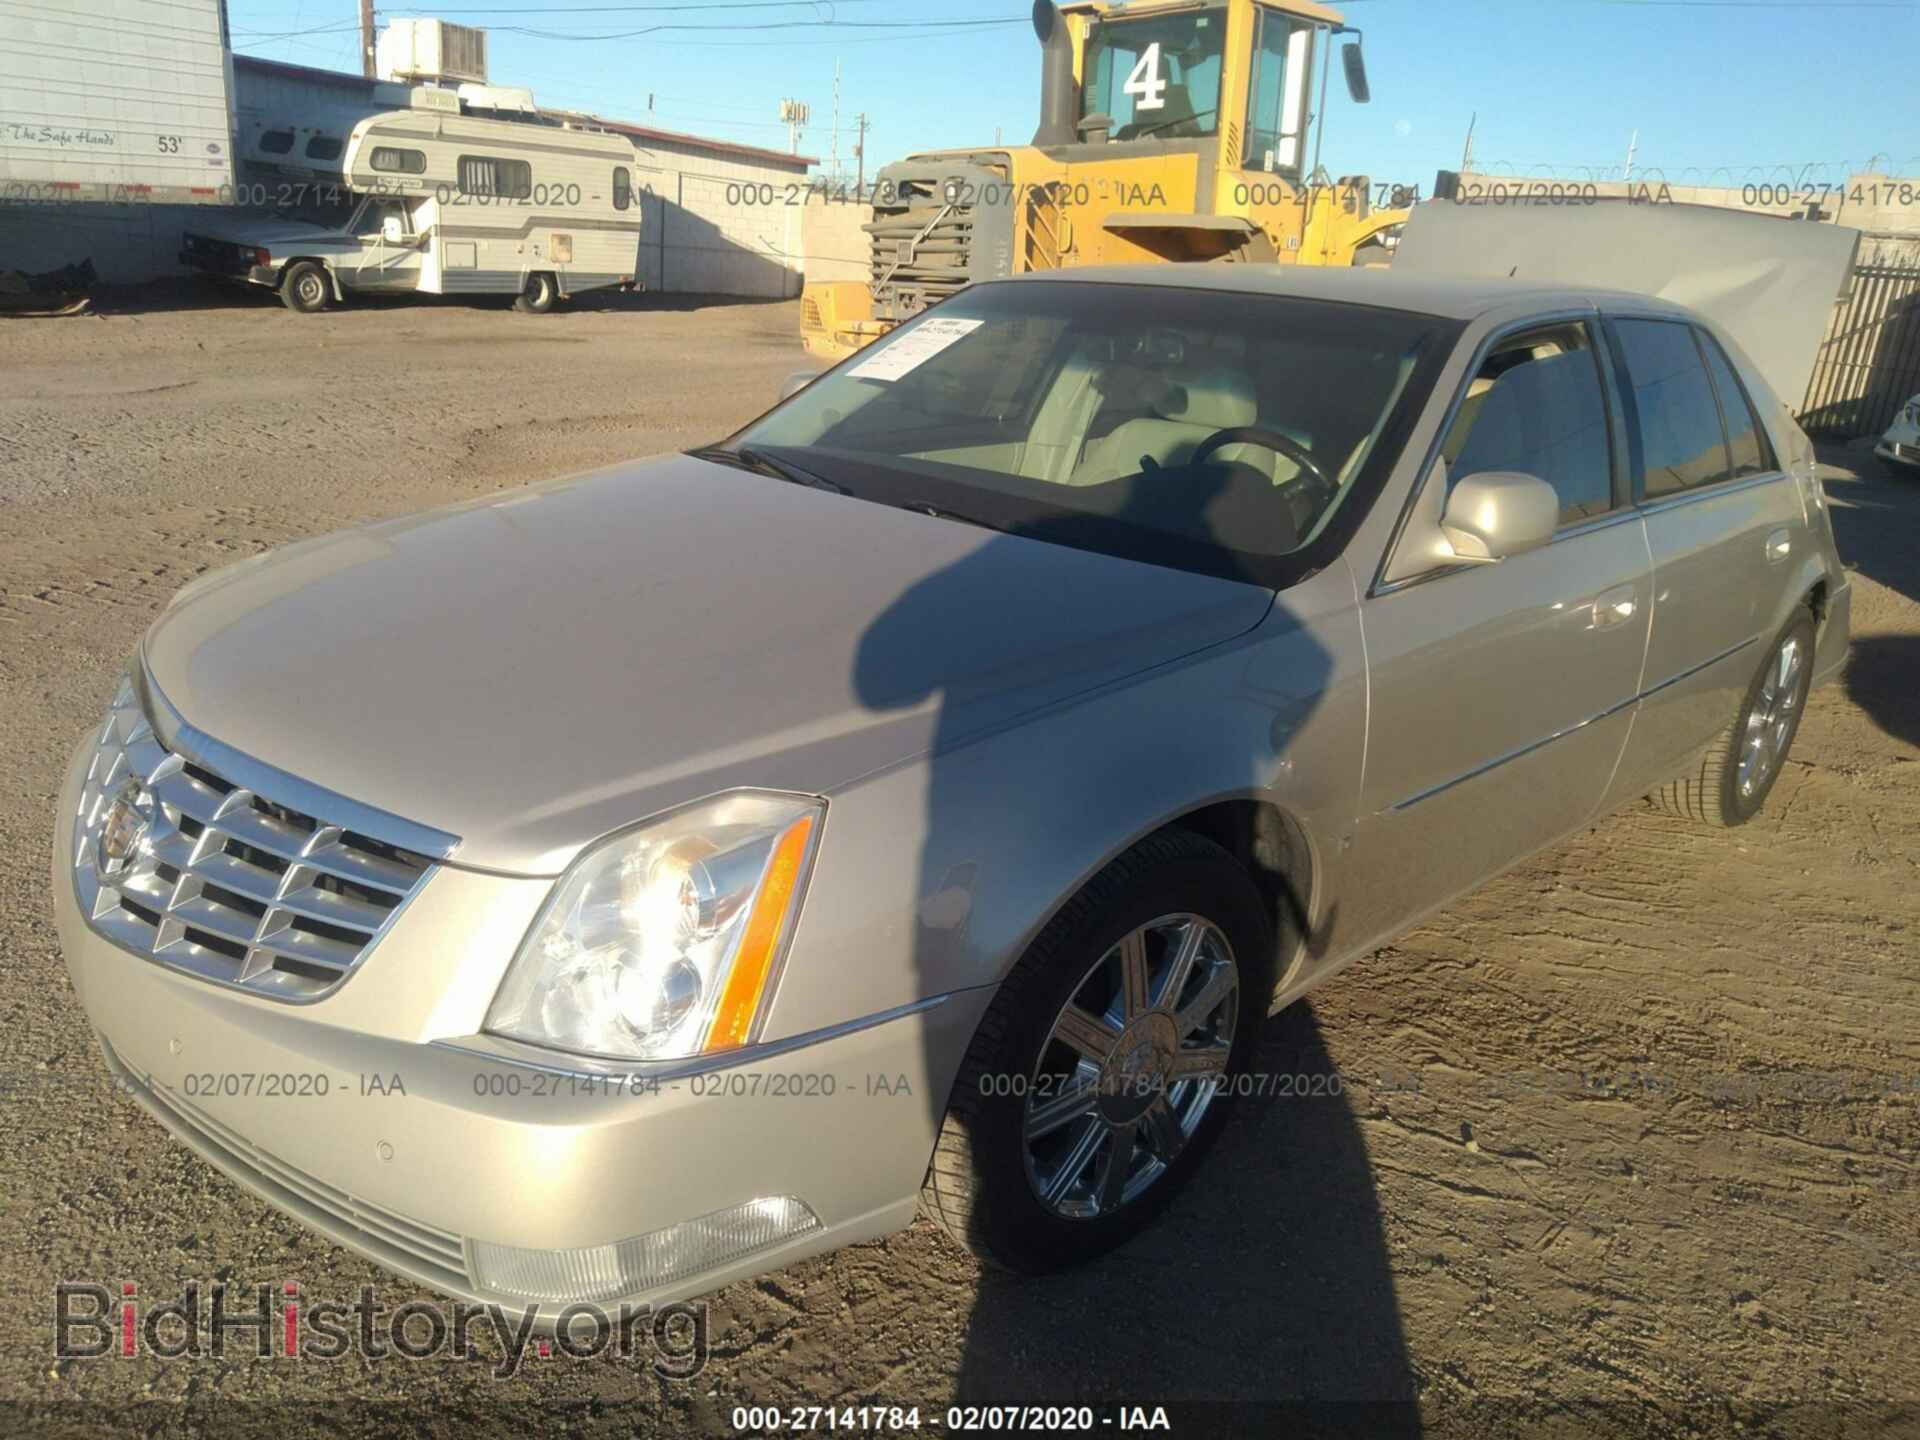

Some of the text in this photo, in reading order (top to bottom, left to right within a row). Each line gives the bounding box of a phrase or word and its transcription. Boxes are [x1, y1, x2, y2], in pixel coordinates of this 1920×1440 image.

[1123, 42, 1166, 110] 4
[38, 127, 73, 146] Safe
[158, 136, 182, 153] 53'
